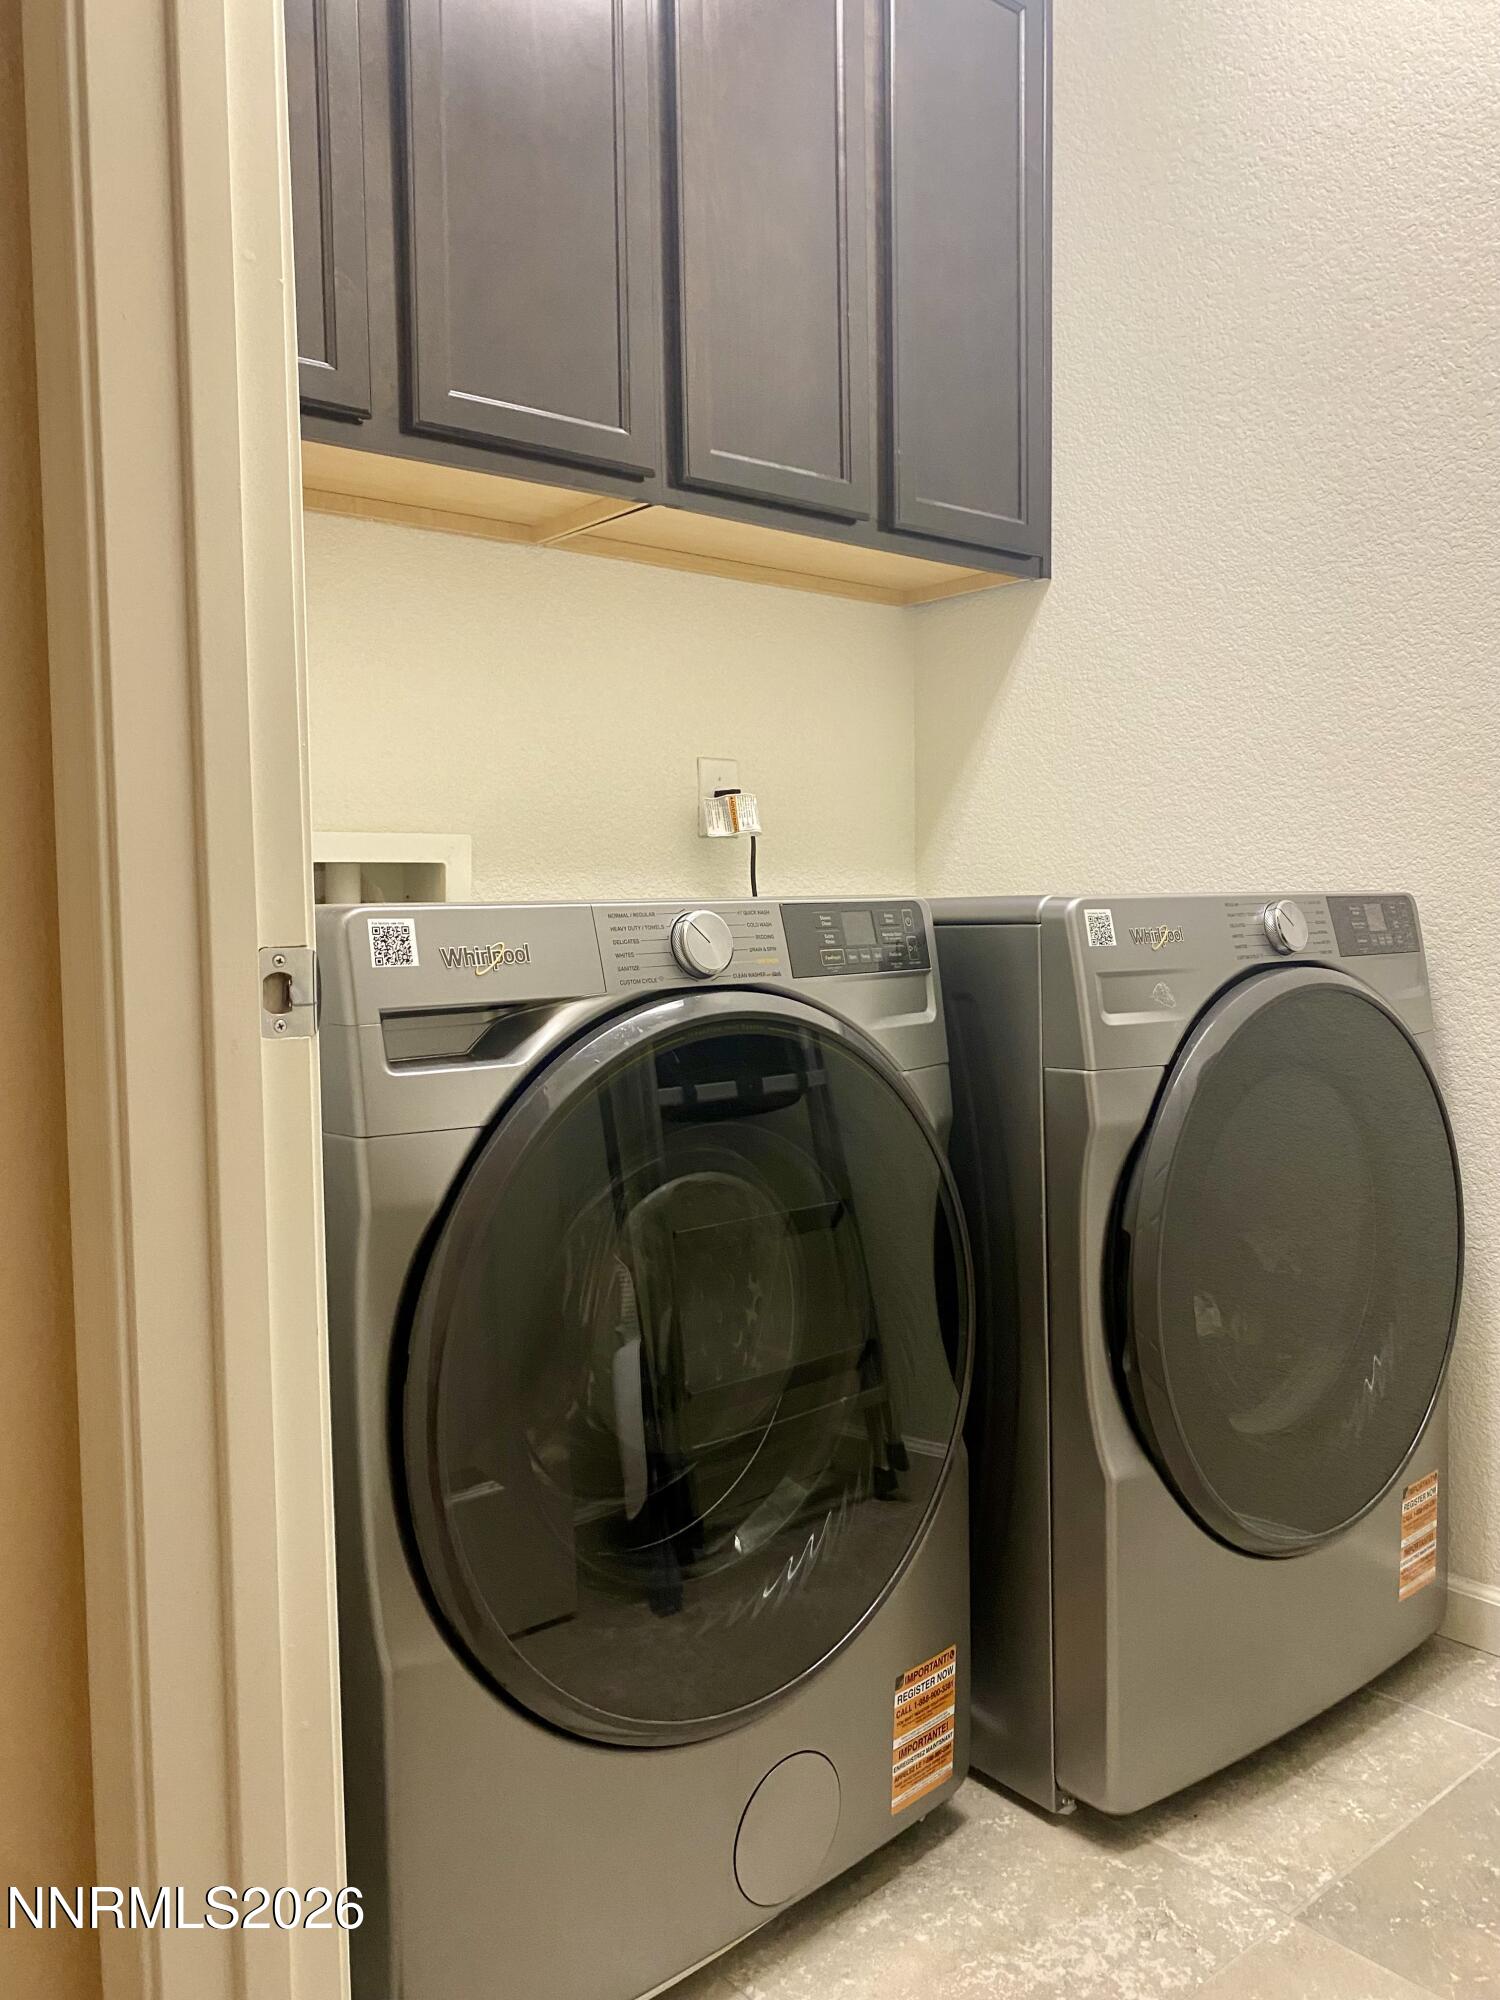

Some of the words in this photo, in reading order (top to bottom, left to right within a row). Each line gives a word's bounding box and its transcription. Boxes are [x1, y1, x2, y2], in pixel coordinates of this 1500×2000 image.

[1129, 925, 1184, 949] Whirlpool
[439, 943, 531, 973] Whirlpool
[897, 1676, 936, 1706] REGISTER
[936, 1665, 954, 1683] NOW
[896, 1704, 913, 1719] CALL
